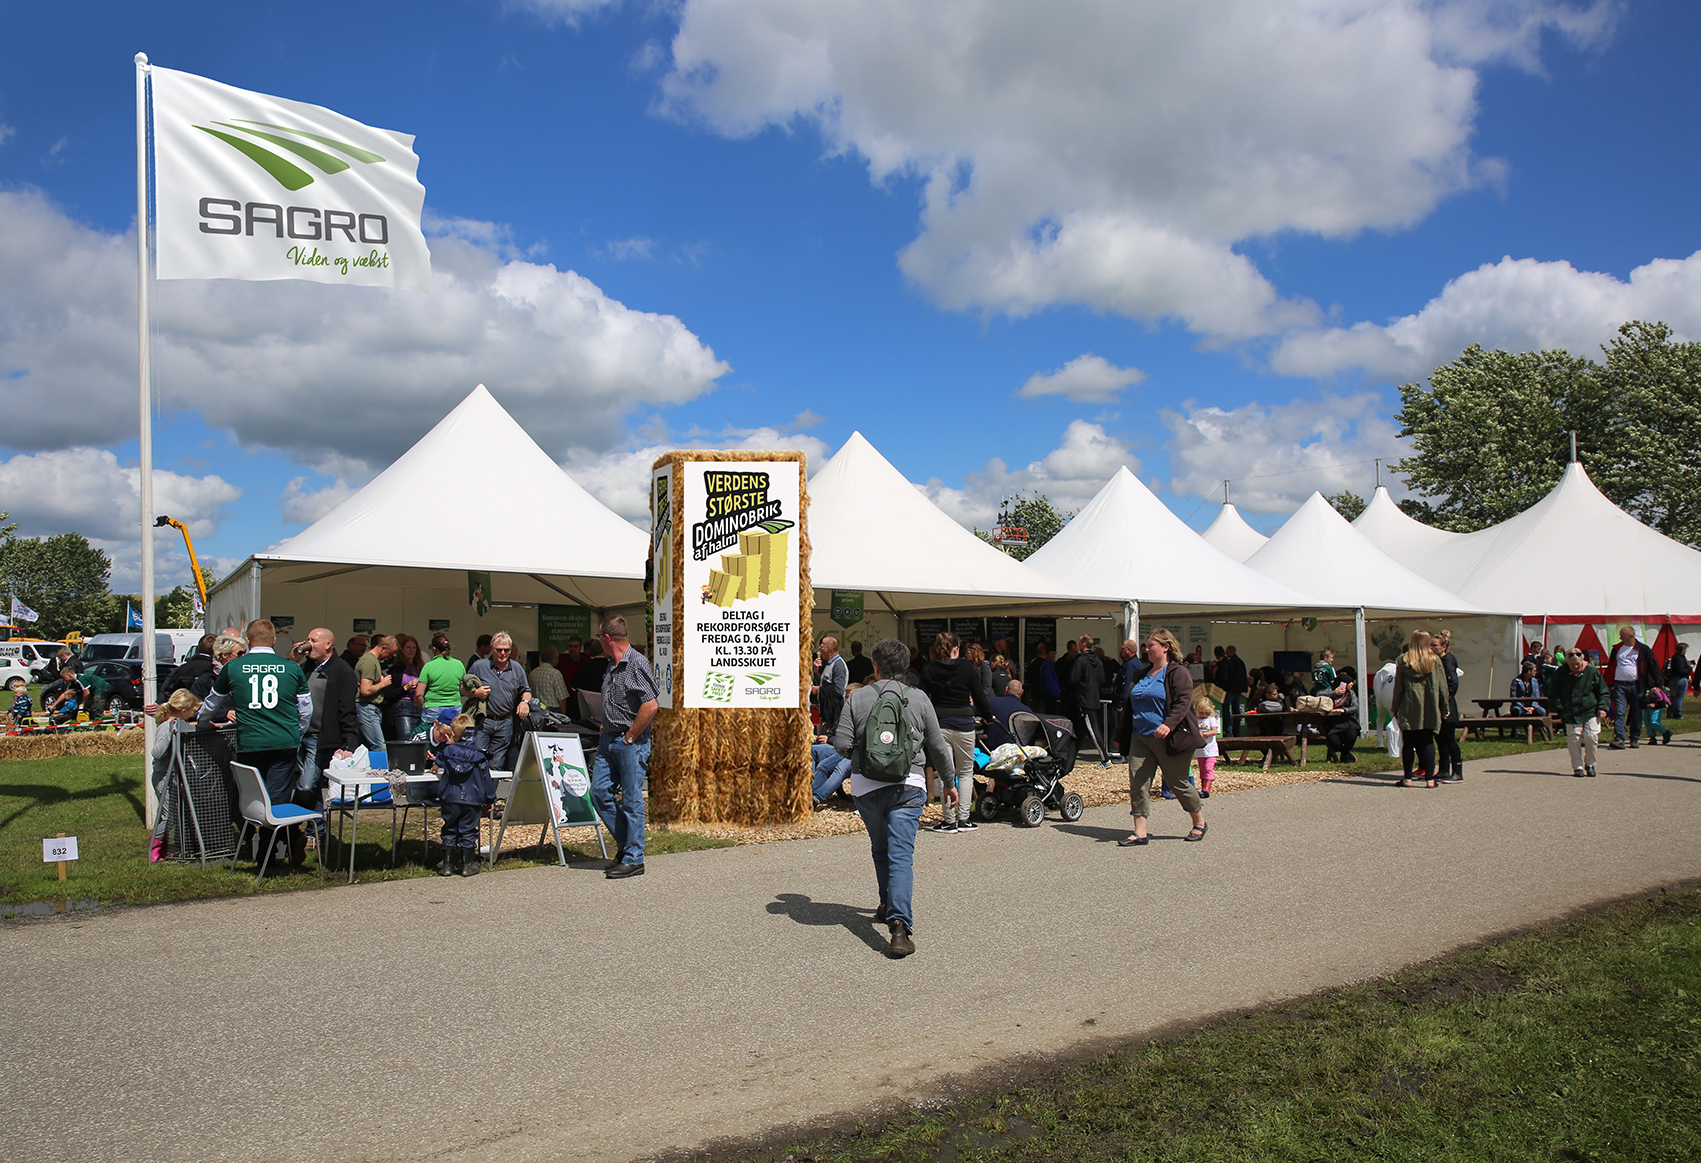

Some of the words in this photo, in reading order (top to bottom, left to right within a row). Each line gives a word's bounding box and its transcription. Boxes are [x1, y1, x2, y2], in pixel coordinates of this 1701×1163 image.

[199, 197, 388, 244] SAGRO
[286, 246, 330, 267] Viden
[334, 257, 350, 275] og
[352, 250, 389, 268] vækst
[707, 474, 767, 493] VERDENS
[709, 491, 765, 517] STØRSTE
[696, 503, 779, 547] DOMINOBRIK
[695, 543, 708, 559] af
[709, 534, 737, 553] halm
[722, 611, 760, 620] DELTAG
[761, 611, 765, 620] I
[697, 622, 791, 633] REKORDFORSØGET
[701, 634, 742, 643] FREDAG
[743, 634, 753, 643] D.
[755, 634, 764, 643] 6.
[765, 634, 785, 645] JULI
[715, 646, 732, 655] KL.
[733, 646, 759, 655] 13.30
[761, 643, 774, 655] PÅ
[242, 665, 285, 674] SAGRO
[710, 658, 777, 667] LANDSSKUET
[248, 674, 279, 710] 18
[745, 687, 781, 695] SAGRO
